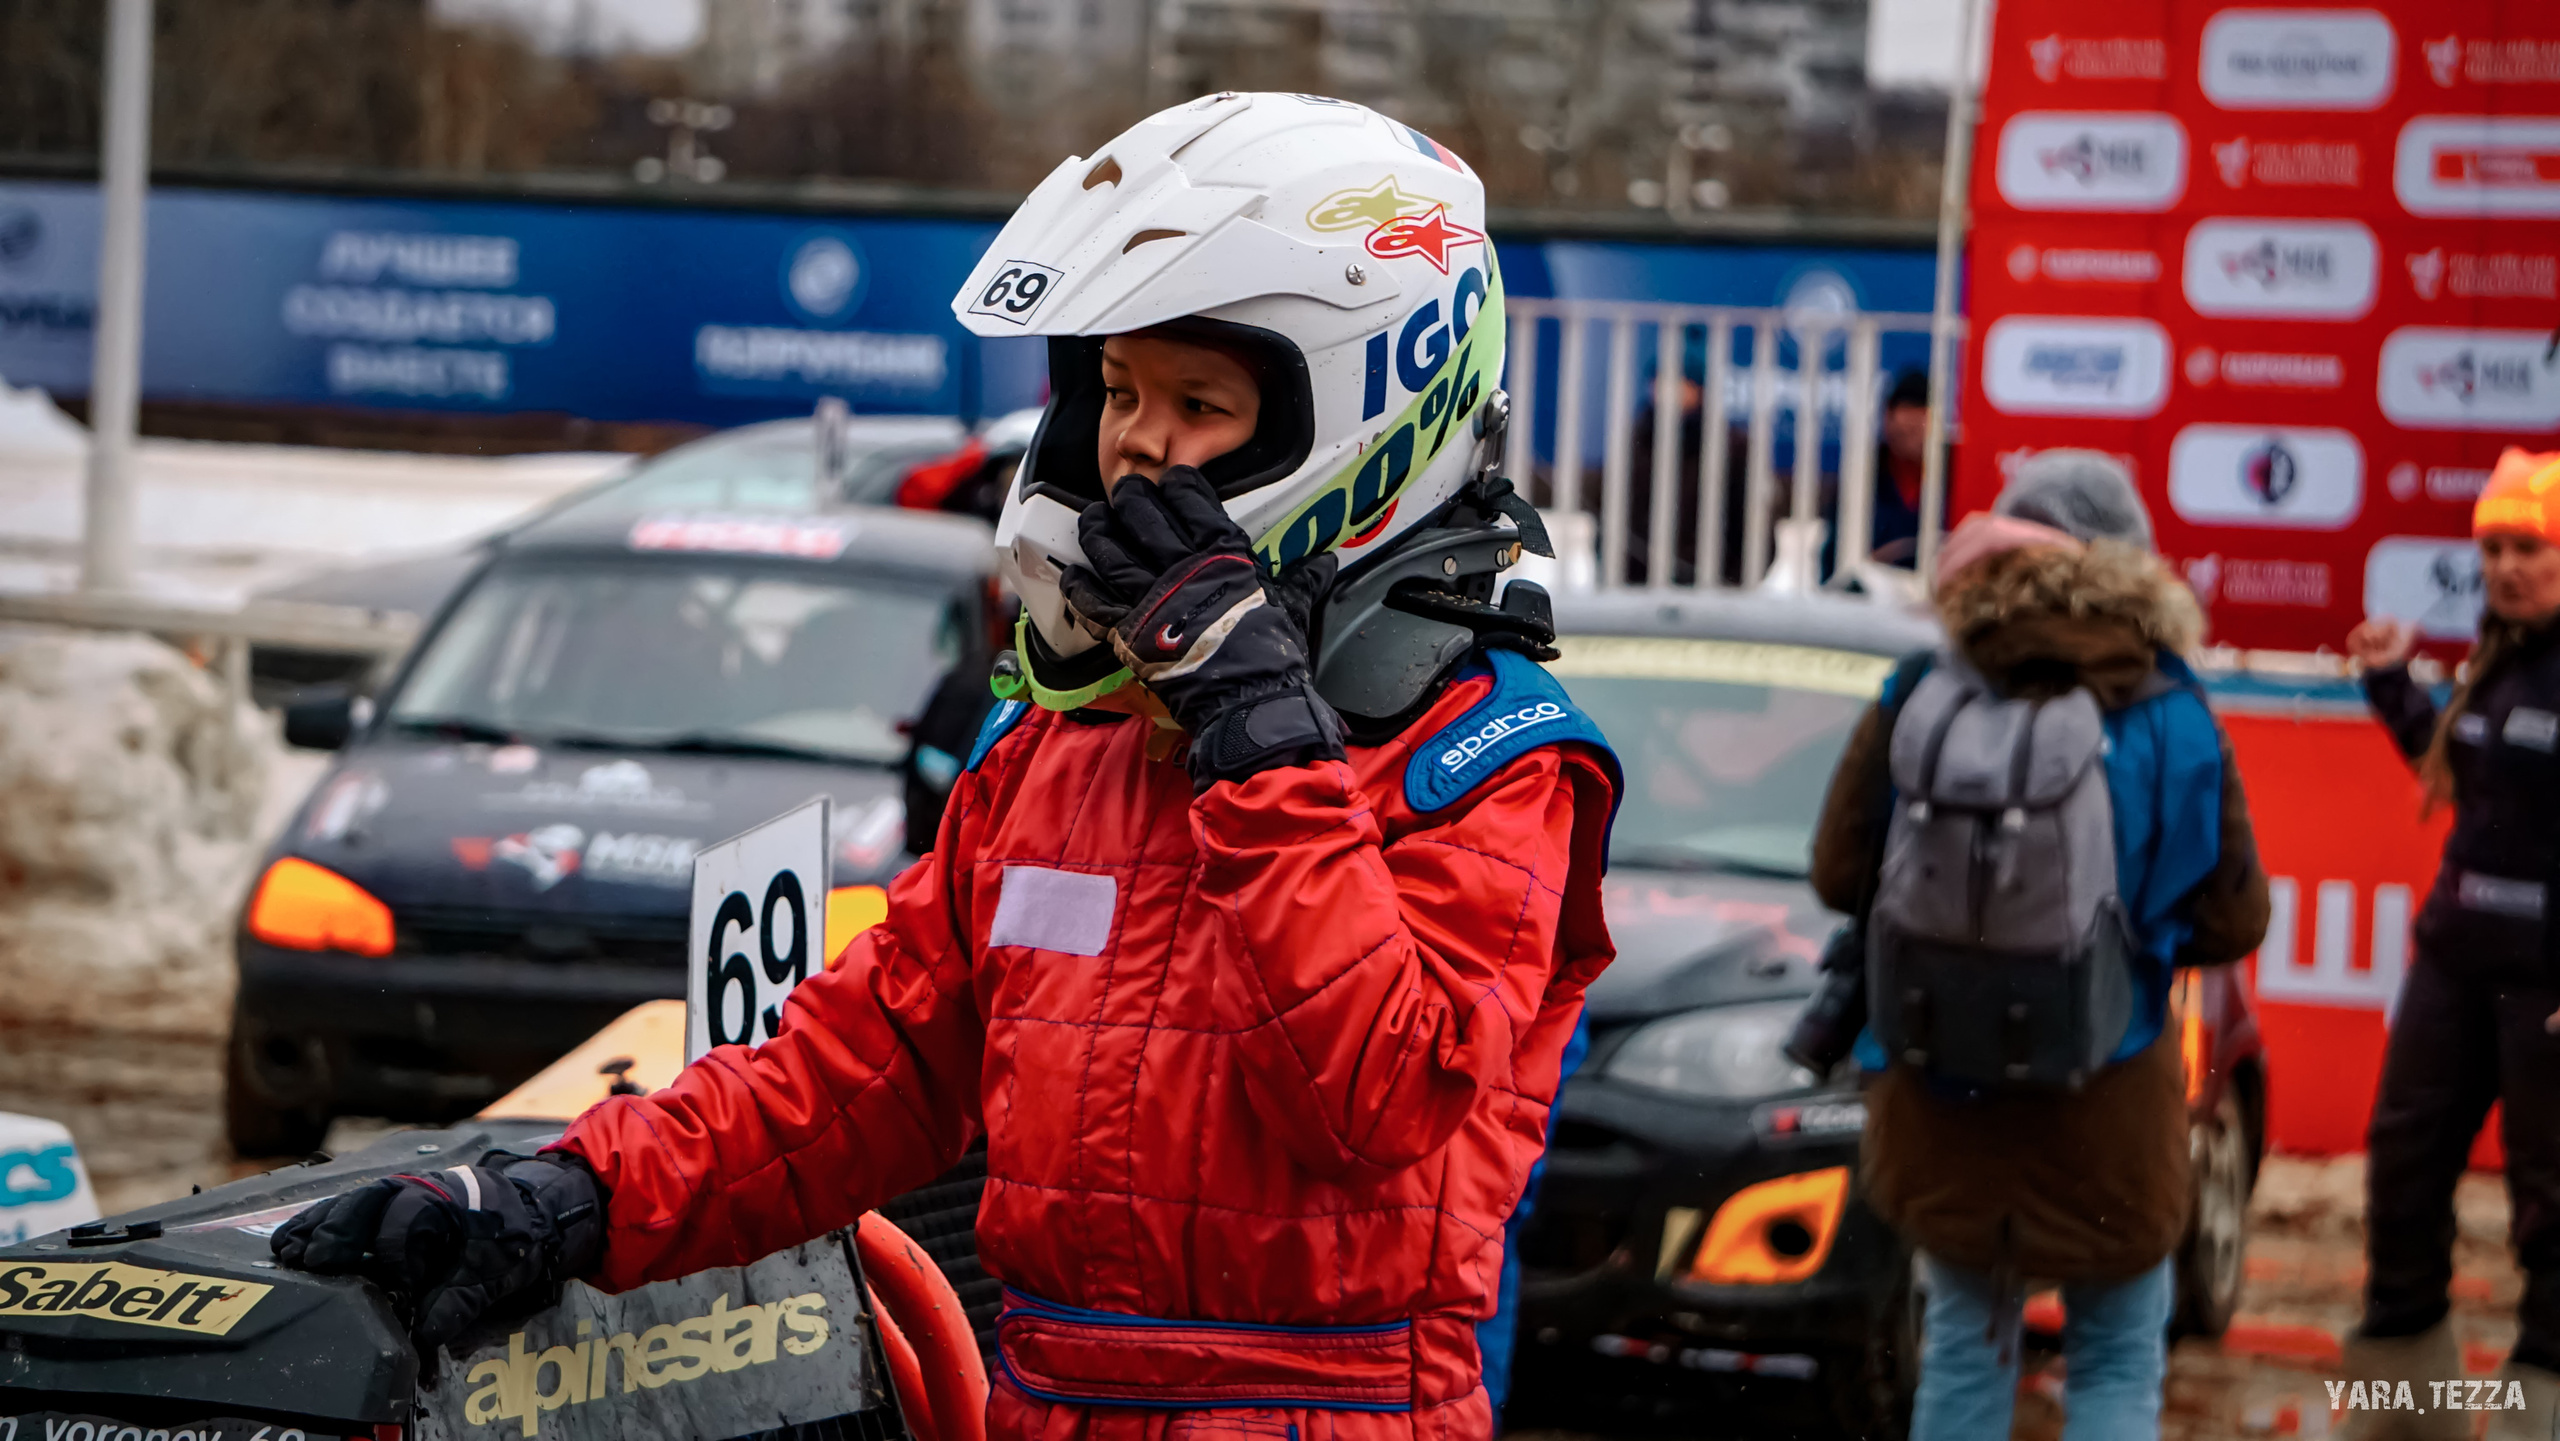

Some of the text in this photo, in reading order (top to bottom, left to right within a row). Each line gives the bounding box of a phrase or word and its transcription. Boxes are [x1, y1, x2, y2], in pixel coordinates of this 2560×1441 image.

[983, 268, 1048, 313] 69
[1362, 250, 1492, 422] IGO
[1441, 702, 1561, 766] sparco
[707, 868, 807, 1049] 69
[0, 1266, 232, 1326] Sabelt
[464, 1292, 830, 1438] alpinestars
